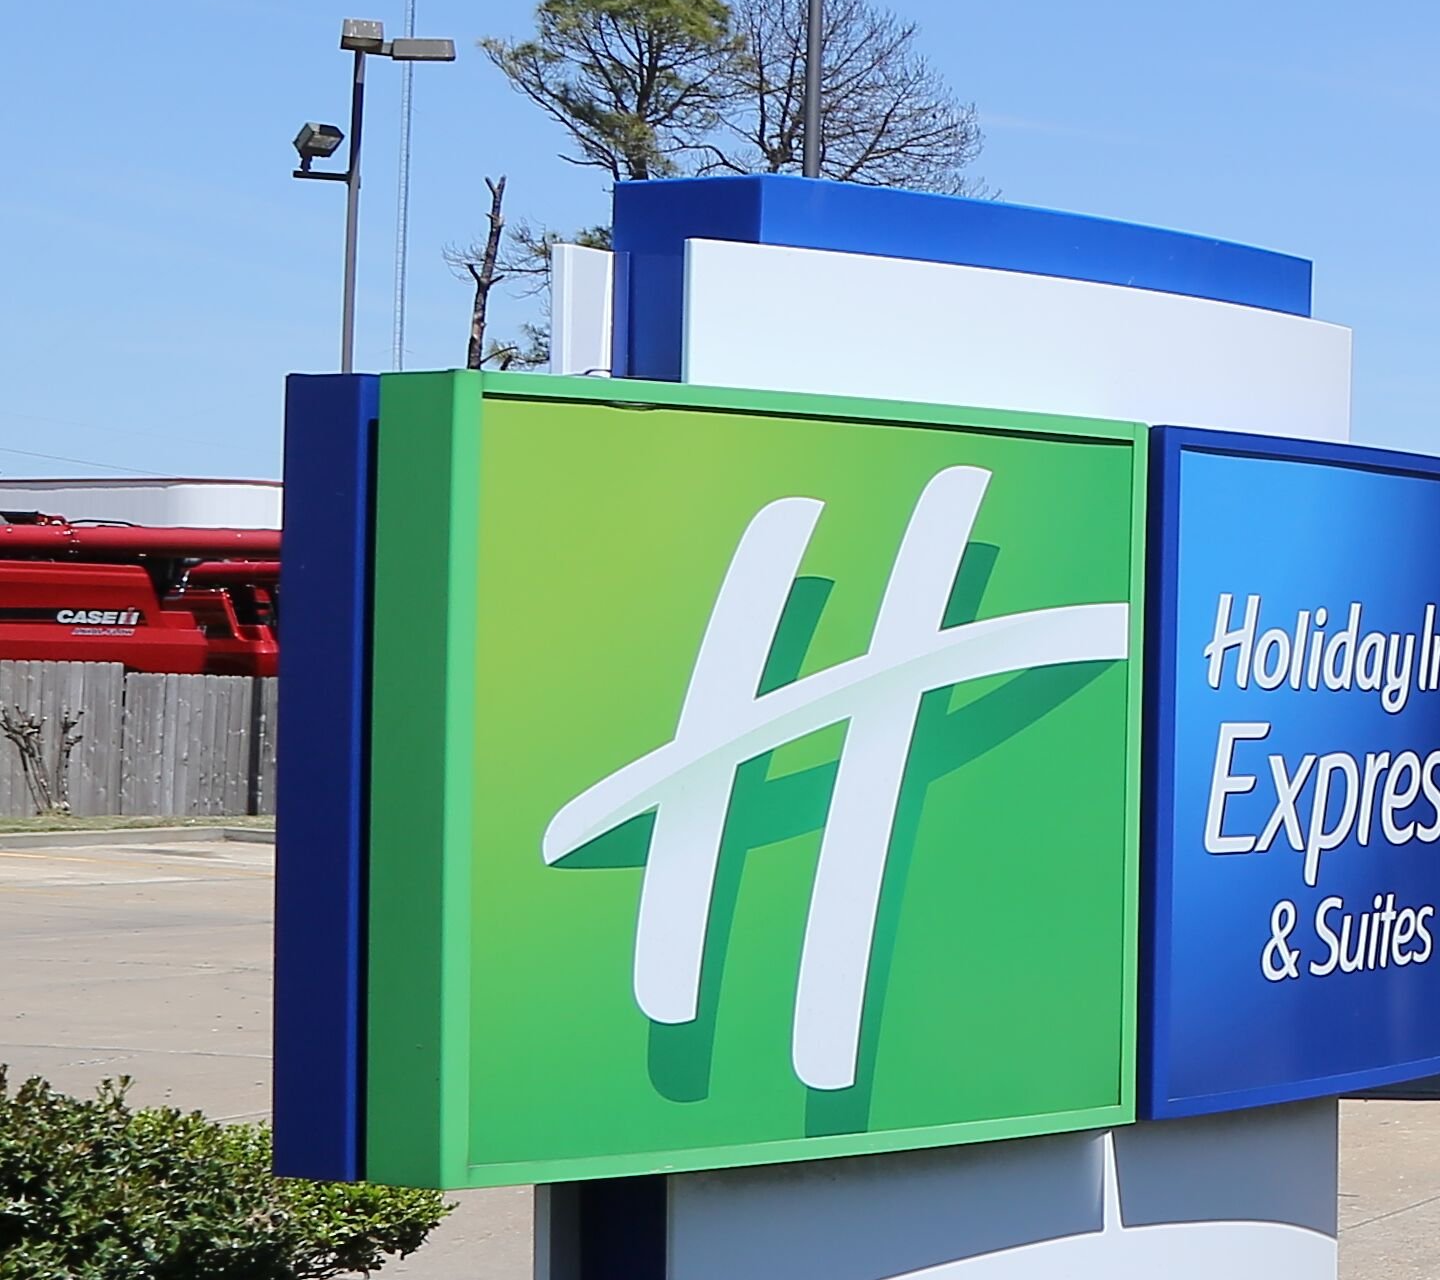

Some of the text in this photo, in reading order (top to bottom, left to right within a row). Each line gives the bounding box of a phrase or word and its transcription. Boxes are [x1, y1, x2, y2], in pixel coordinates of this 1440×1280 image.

[1204, 593, 1415, 713] Holiday
[1260, 893, 1434, 981] & Suites
